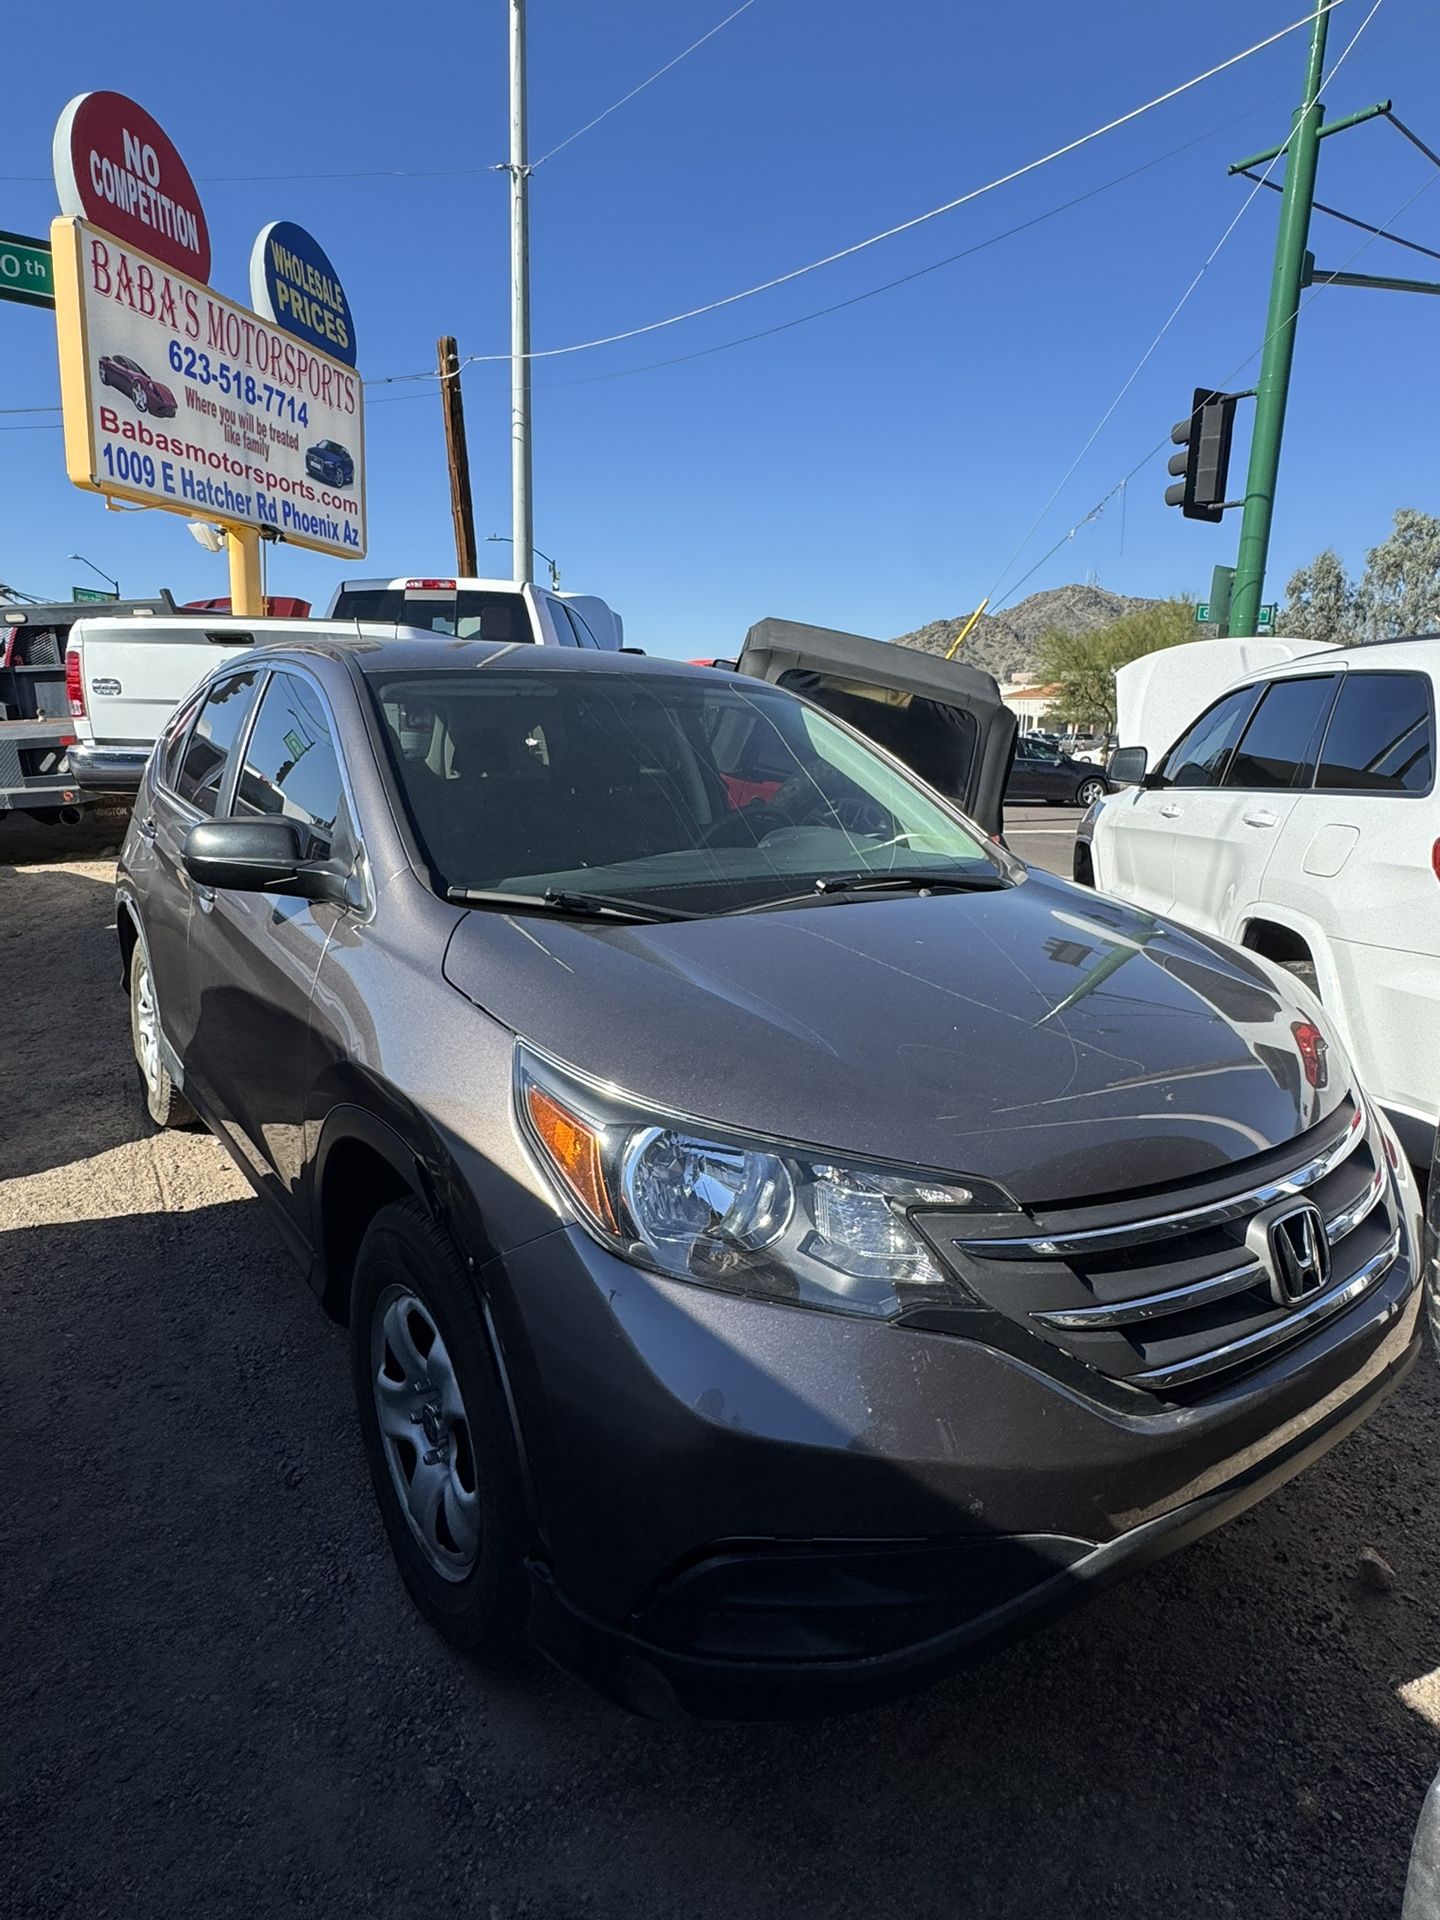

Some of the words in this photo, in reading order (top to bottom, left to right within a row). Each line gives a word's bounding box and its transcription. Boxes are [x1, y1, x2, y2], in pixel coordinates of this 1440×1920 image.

[122, 127, 160, 188] NO
[90, 149, 200, 255] COMPETITION
[270, 239, 344, 315] WHOLESALE
[276, 278, 349, 349] PRICES
[91, 239, 201, 341] BABA'S
[206, 299, 356, 415] MOTORSPORTS
[168, 339, 309, 429] 623-518-7714
[184, 385, 217, 418] Where
[219, 405, 236, 426] you
[238, 411, 254, 433] will
[256, 416, 267, 438] be
[269, 422, 299, 452] treated
[100, 405, 359, 515] Babasmotorsports.com
[223, 422, 241, 447] like
[243, 430, 270, 463] family
[103, 442, 156, 488] 1009
[161, 460, 176, 494] E
[180, 466, 252, 516] Hatcher
[256, 490, 278, 524] Rd
[281, 499, 340, 541] Phoenix
[343, 519, 359, 547] Az
